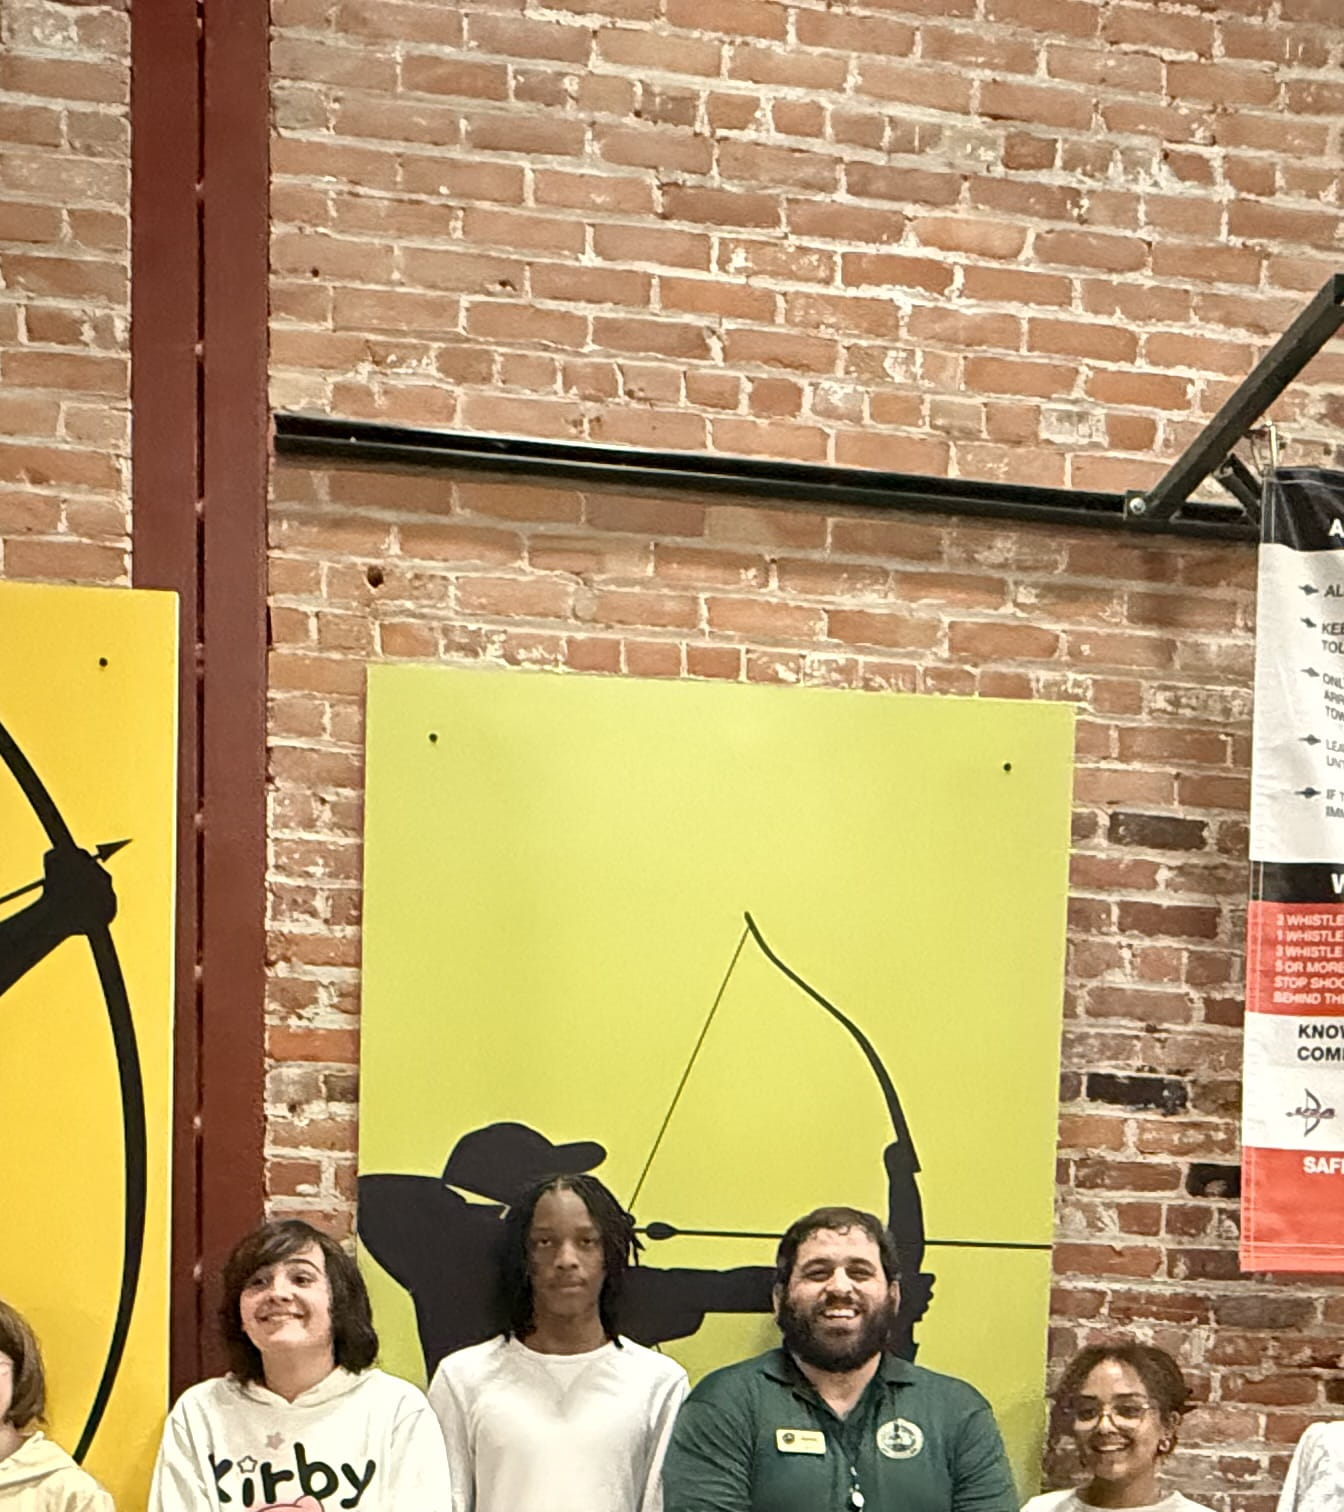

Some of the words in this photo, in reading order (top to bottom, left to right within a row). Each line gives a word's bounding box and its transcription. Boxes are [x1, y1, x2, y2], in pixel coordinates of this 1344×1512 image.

[1326, 789, 1336, 800] IF
[1286, 914, 1344, 927] WHISTLE
[1286, 929, 1344, 942] WHISTLE
[1286, 945, 1343, 958] WHISTLE
[1285, 961, 1303, 973] OR
[1307, 961, 1344, 973] MORE
[1274, 976, 1307, 989] STOP
